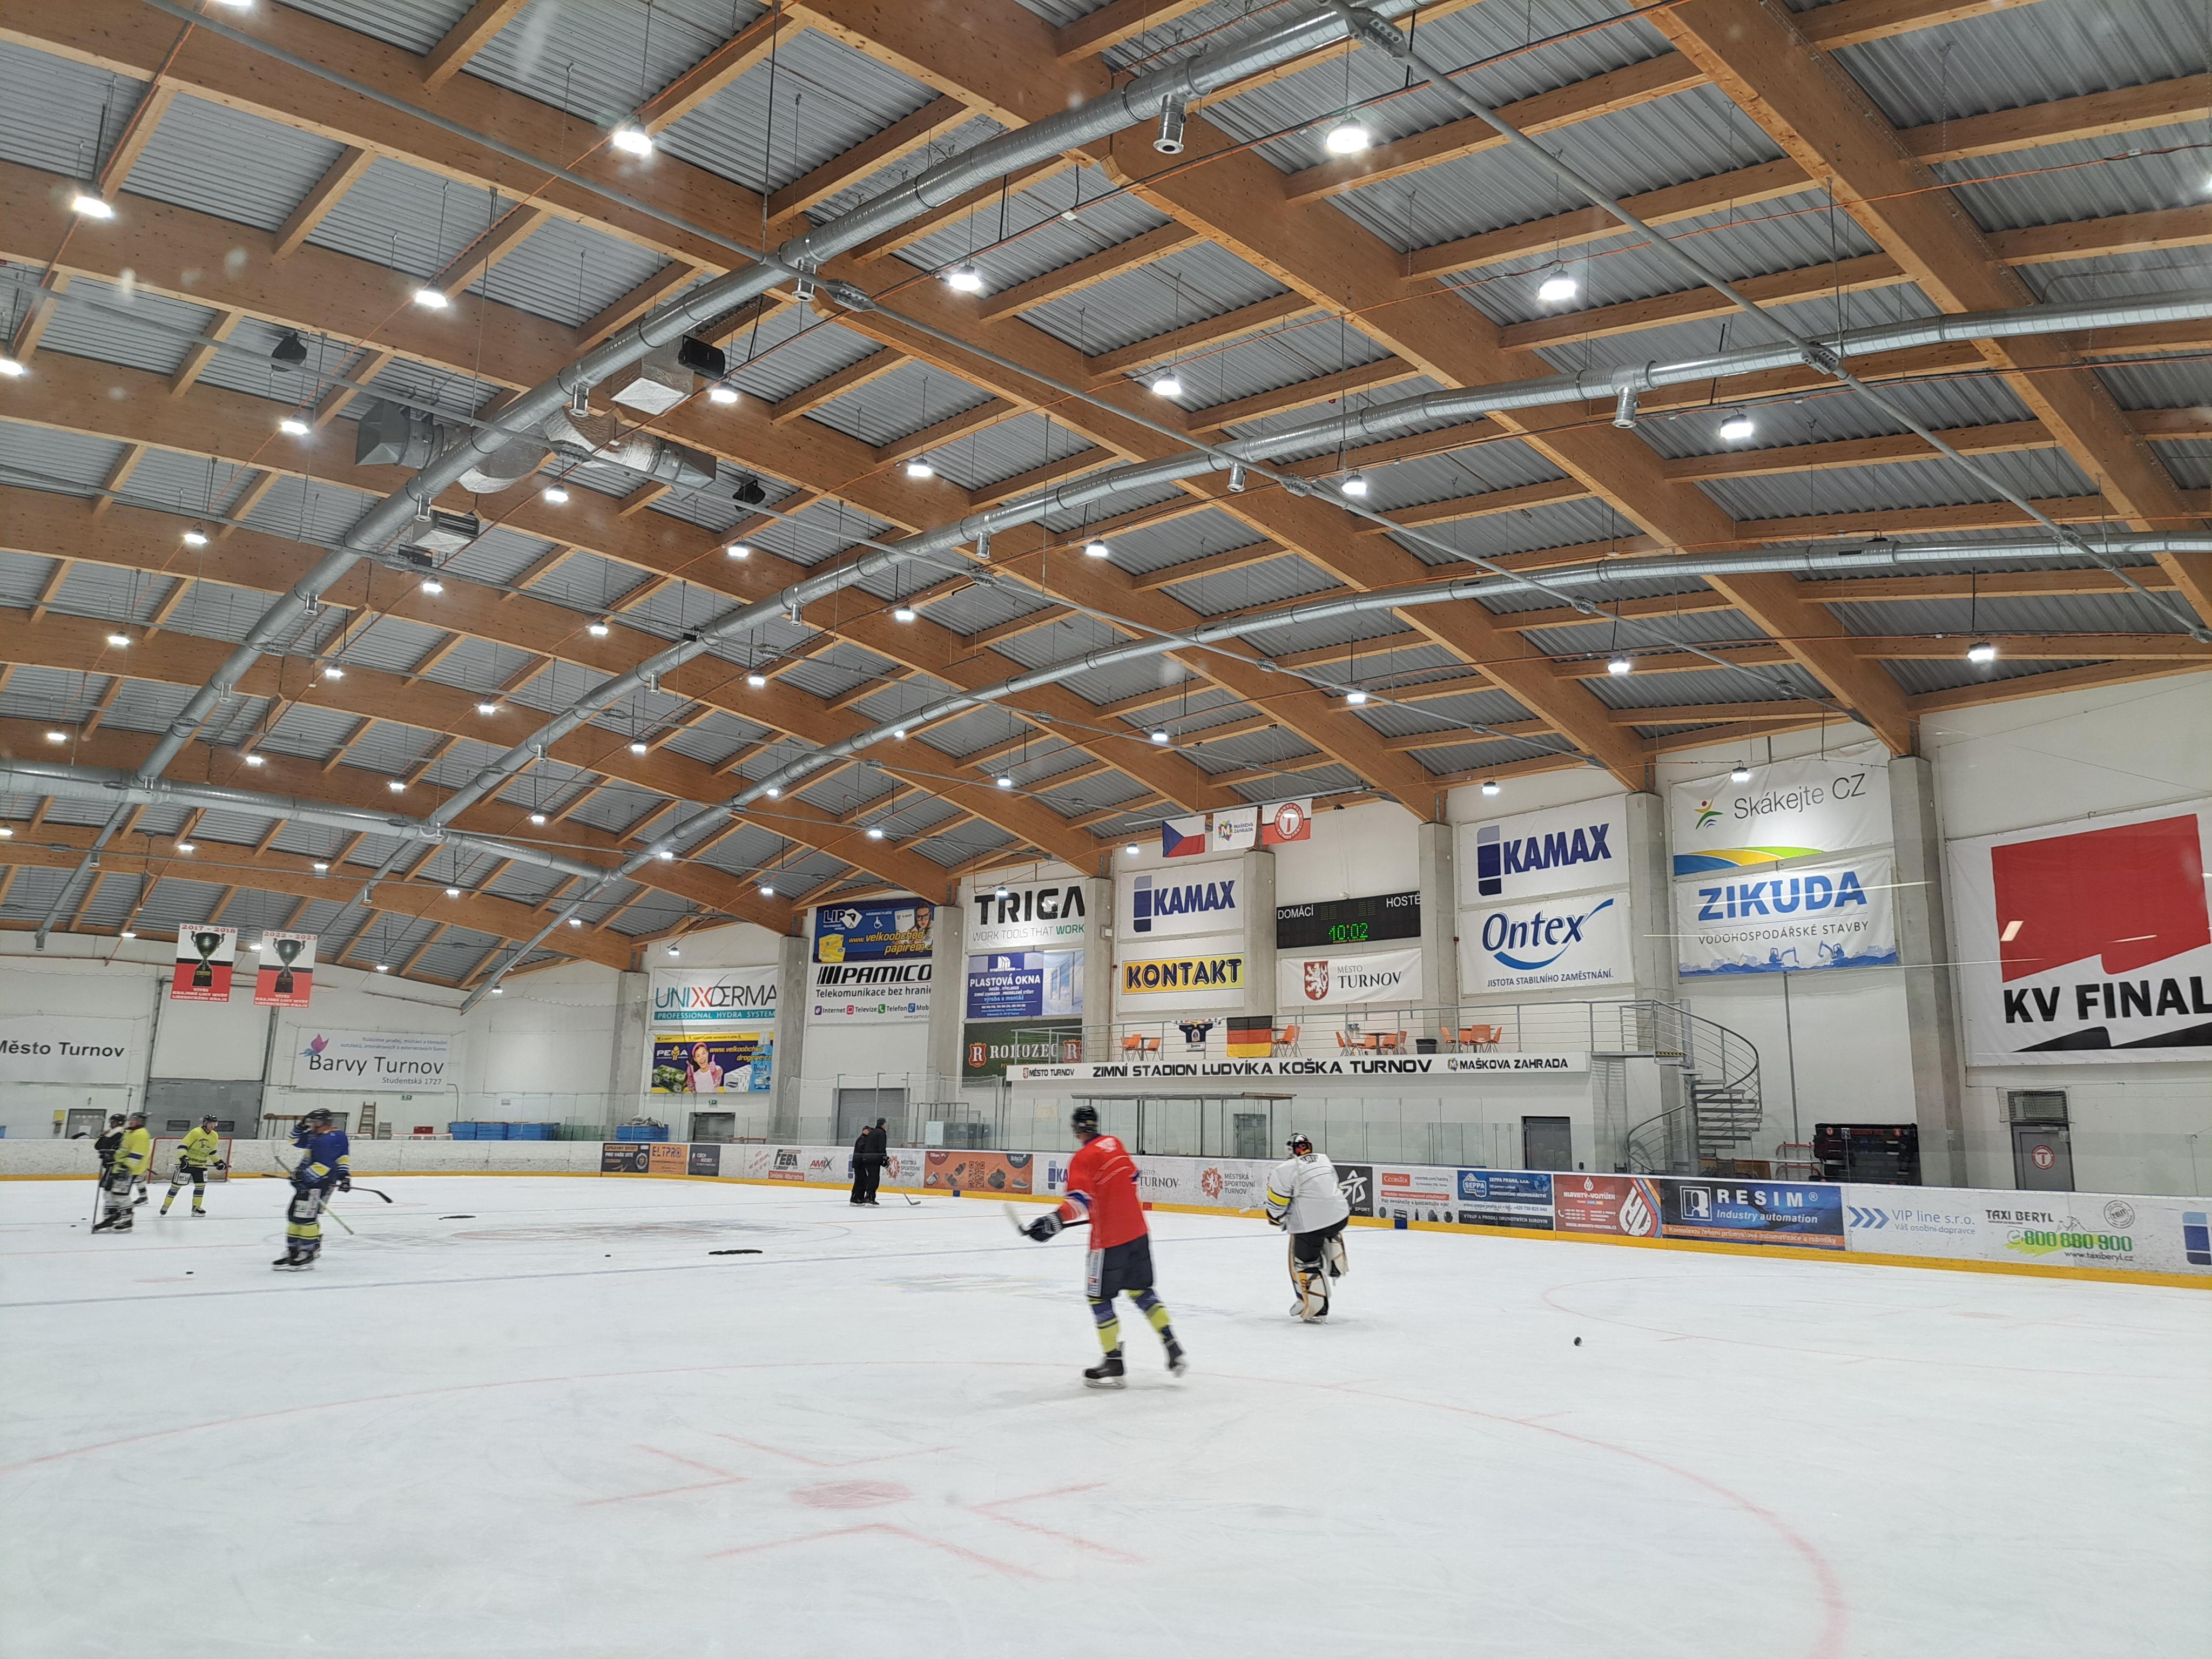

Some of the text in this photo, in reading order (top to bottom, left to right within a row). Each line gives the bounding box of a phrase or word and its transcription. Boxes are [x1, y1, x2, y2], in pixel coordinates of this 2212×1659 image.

[1734, 773, 1866, 819] Skákejte CZ
[1503, 824, 1612, 874] KAMAX
[1154, 880, 1236, 916] KAMAX
[1698, 871, 1867, 921] ZIKUDA
[974, 886, 1085, 925] TRIGA
[1278, 905, 1314, 919] DOMÁCÍ
[973, 923, 1085, 942] WORK TOOLS THAT WORK
[1482, 910, 1588, 951] Ontex
[1699, 921, 1869, 945] VODOHOSPODÁŘSKÉ STAVBY
[840, 965, 932, 984] PAMICO
[1127, 959, 1242, 989] KONTAKT
[1337, 964, 1363, 974] MĚSTO
[1487, 968, 1614, 987] JISTOTA STABILNÍHO ZAMĚSTNÁNÍ.
[970, 974, 1041, 987] PLASTOVÁ OKNA
[1337, 971, 1403, 989] TURNOV
[816, 988, 886, 998] Telekomunikace
[888, 987, 902, 995] bez
[2004, 976, 2212, 1023] KV FINAL
[746, 1010, 775, 1018] SYSTEM
[58, 1042, 125, 1057] Turnov
[972, 1046, 983, 1062] R
[309, 1054, 444, 1076] Barvy Turnov
[1029, 1068, 1075, 1077] MĚSTO TURNOV
[1092, 1058, 1433, 1077] ZIMNÍ STADION LUDVÍKA KOŠKA TURNOV
[1460, 1058, 1568, 1070] MAŠKOVA ZAHRADA
[382, 1077, 422, 1085] Studentská
[774, 1149, 798, 1166] FEBA
[2037, 1152, 2048, 1164] T
[1139, 1176, 1179, 1188] TURNOV
[1717, 1189, 1803, 1207] RESIM
[1717, 1209, 1818, 1224] Industry automation
[1892, 1209, 1912, 1221] VIP
[1917, 1210, 1940, 1223] line
[1945, 1215, 1975, 1225] s.r.o.
[1985, 1209, 2011, 1220] TAXI
[2015, 1211, 2054, 1223] BERYL
[1669, 1227, 1701, 1236] Komplexní
[1759, 1232, 1802, 1240] automatizace
[1810, 1236, 1836, 1244] robotiky
[1938, 1226, 1975, 1235] dopravce
[2025, 1230, 2133, 1252] 800 880 900
[2064, 1251, 2134, 1262] www.taxiberyl.cz
